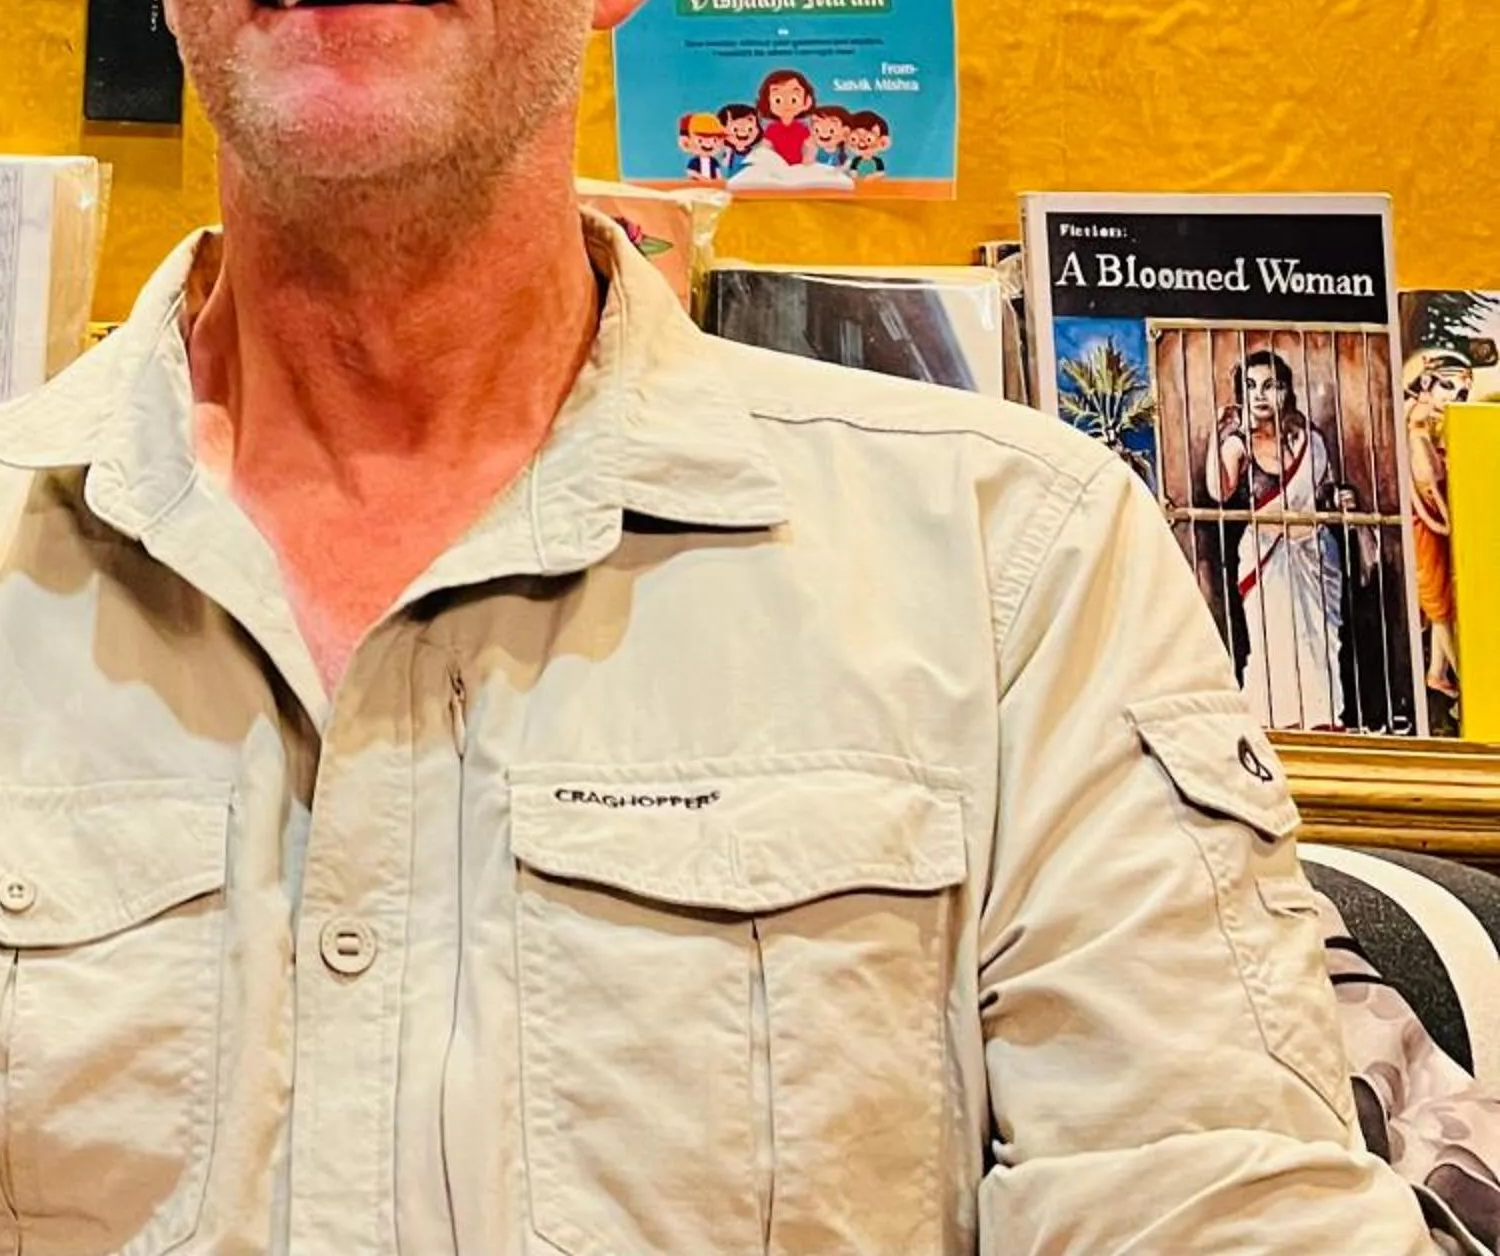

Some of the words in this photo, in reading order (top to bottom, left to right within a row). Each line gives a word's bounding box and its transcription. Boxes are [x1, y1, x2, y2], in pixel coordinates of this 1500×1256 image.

[1055, 251, 1087, 287] A
[1095, 253, 1250, 291] Bloomed
[1256, 257, 1376, 297] Woman
